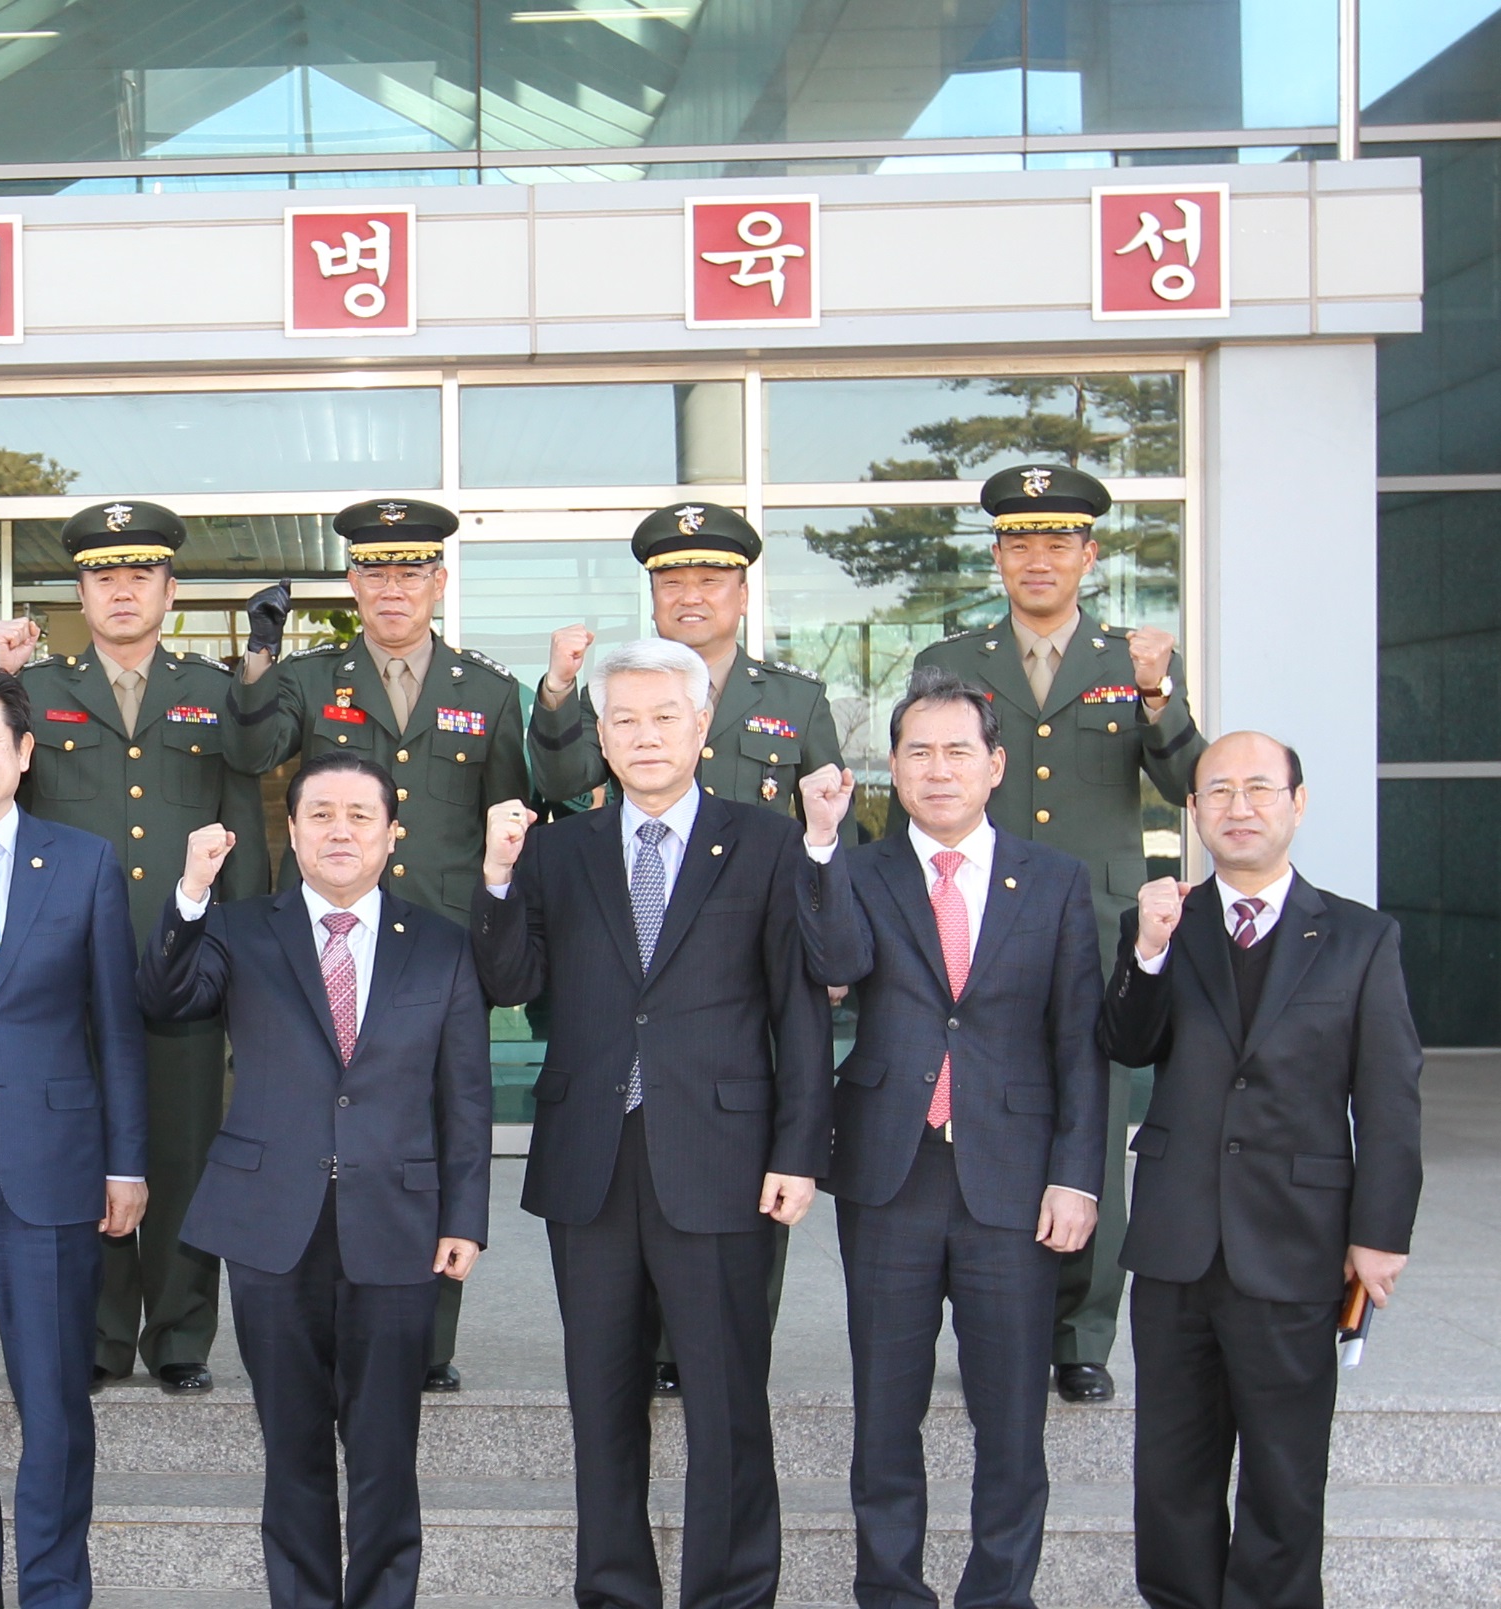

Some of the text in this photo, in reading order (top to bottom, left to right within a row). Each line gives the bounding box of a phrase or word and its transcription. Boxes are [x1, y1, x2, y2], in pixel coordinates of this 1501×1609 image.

[310, 220, 391, 318] 병
[701, 211, 806, 307] 육
[1115, 198, 1203, 301] 성
